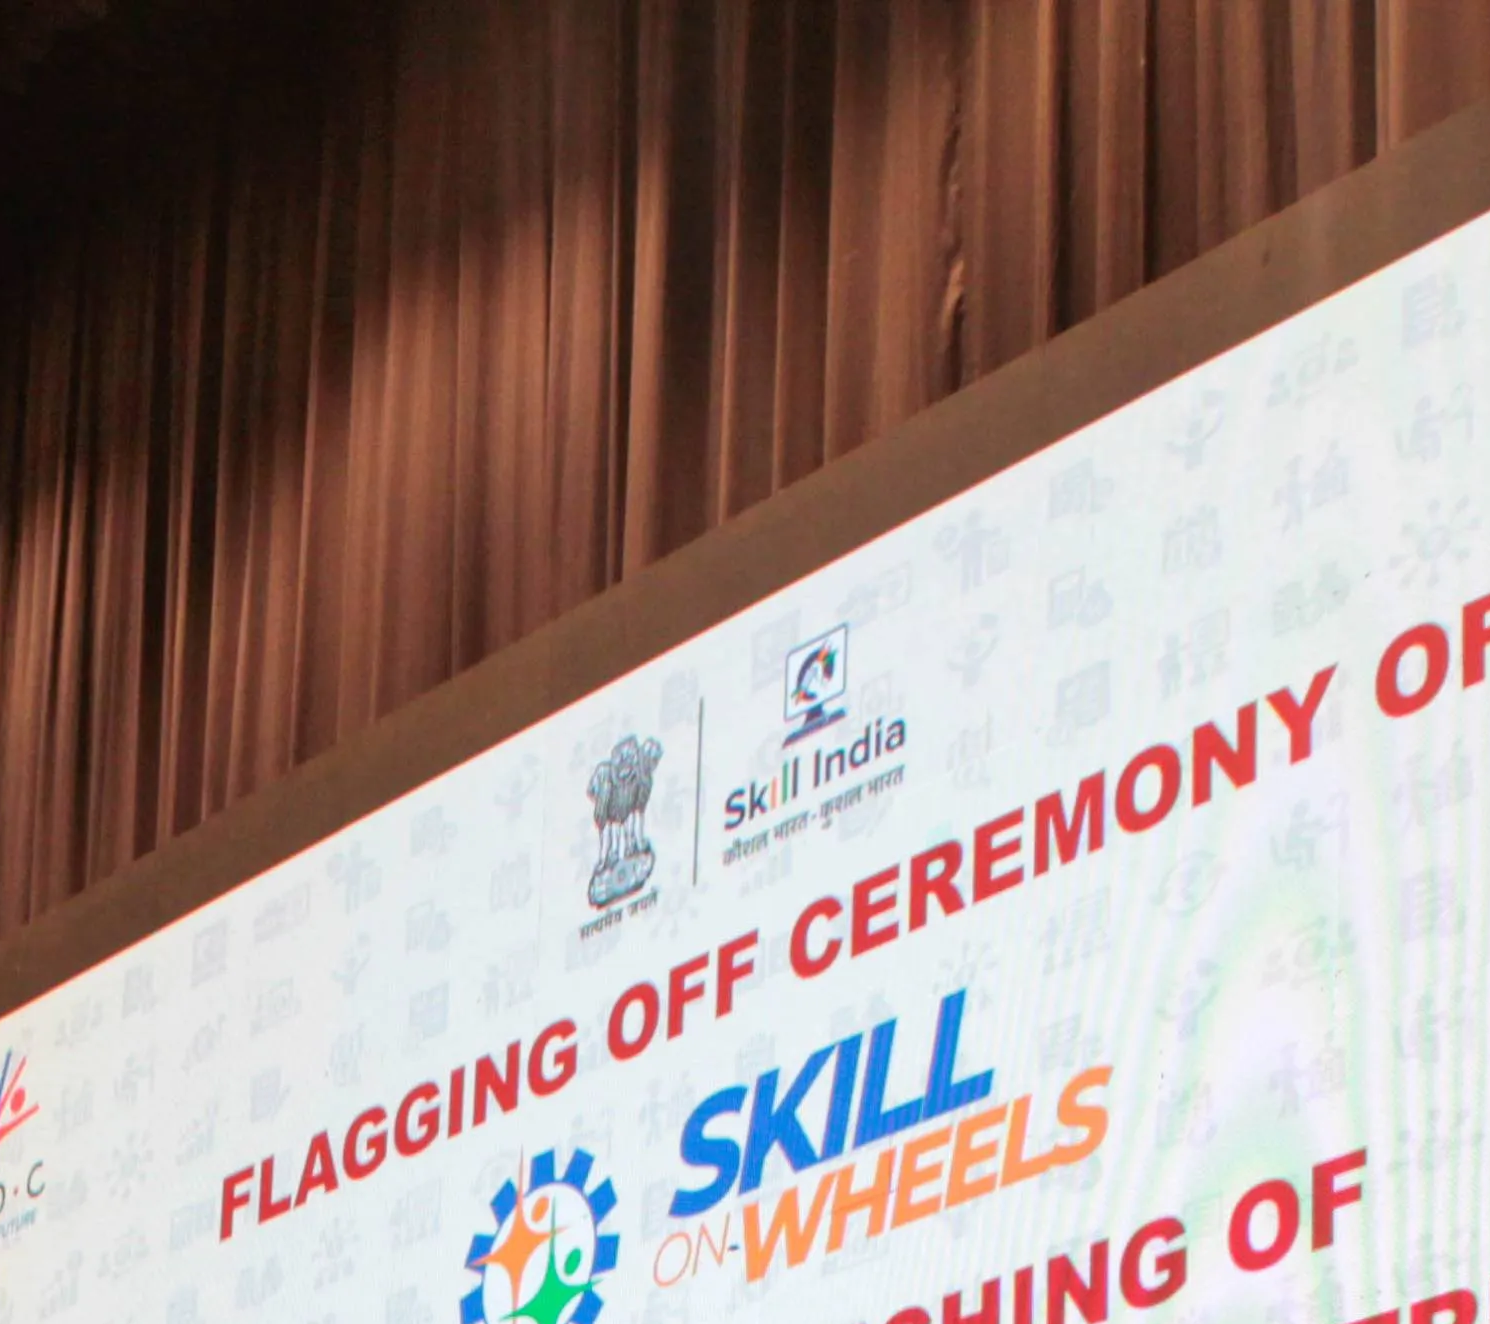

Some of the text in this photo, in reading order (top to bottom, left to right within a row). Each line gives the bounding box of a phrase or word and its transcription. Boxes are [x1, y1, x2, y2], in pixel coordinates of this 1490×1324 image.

[724, 716, 907, 831] Skill India
[220, 1020, 577, 1241] FLAGGING
[607, 932, 758, 1062] OFF
[790, 669, 1336, 980] CEREMONY
[668, 990, 995, 1218] SKILL
[1228, 1151, 1367, 1273] OF
